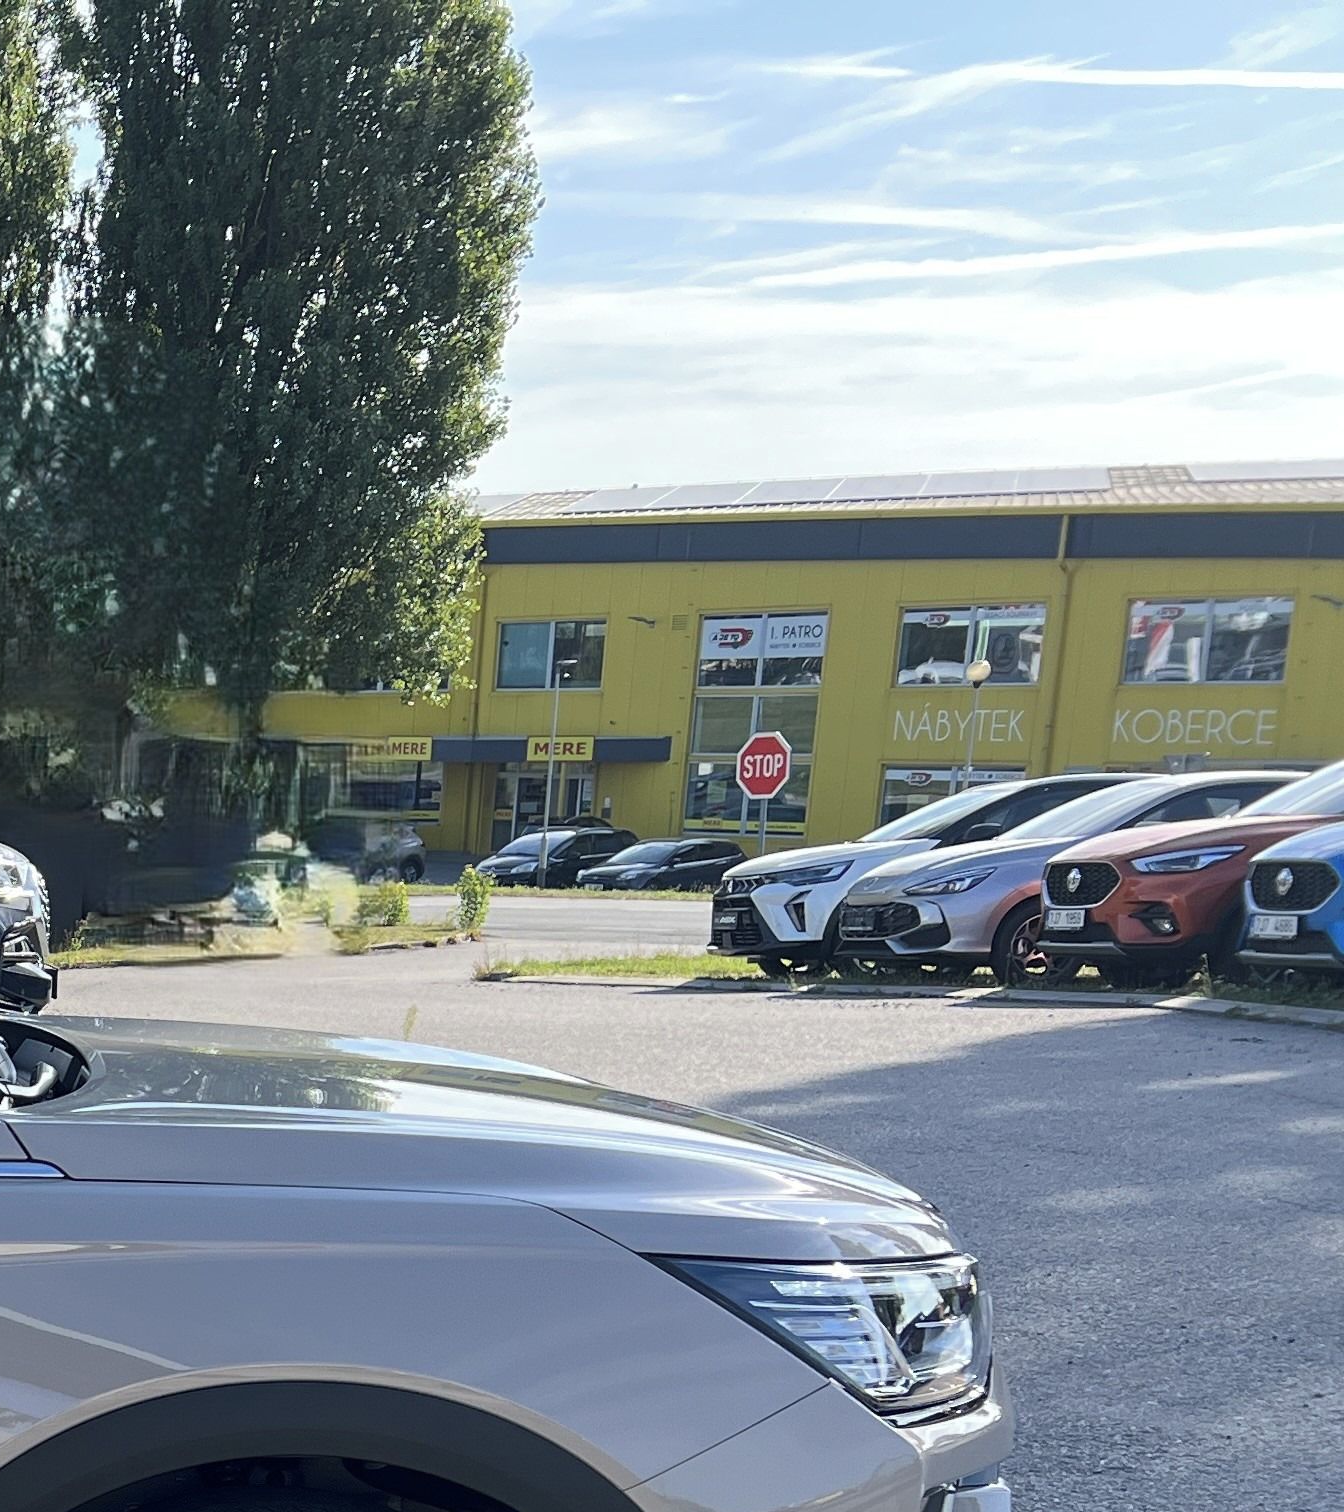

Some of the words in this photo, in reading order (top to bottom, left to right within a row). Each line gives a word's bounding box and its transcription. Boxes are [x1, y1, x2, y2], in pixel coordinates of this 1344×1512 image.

[782, 624, 823, 639] PATRO
[892, 702, 1025, 743] NÁBYTEK
[1112, 709, 1278, 745] KOBERCE
[391, 741, 427, 756] MERE
[533, 741, 587, 756] MERE
[742, 753, 784, 779] STOP
